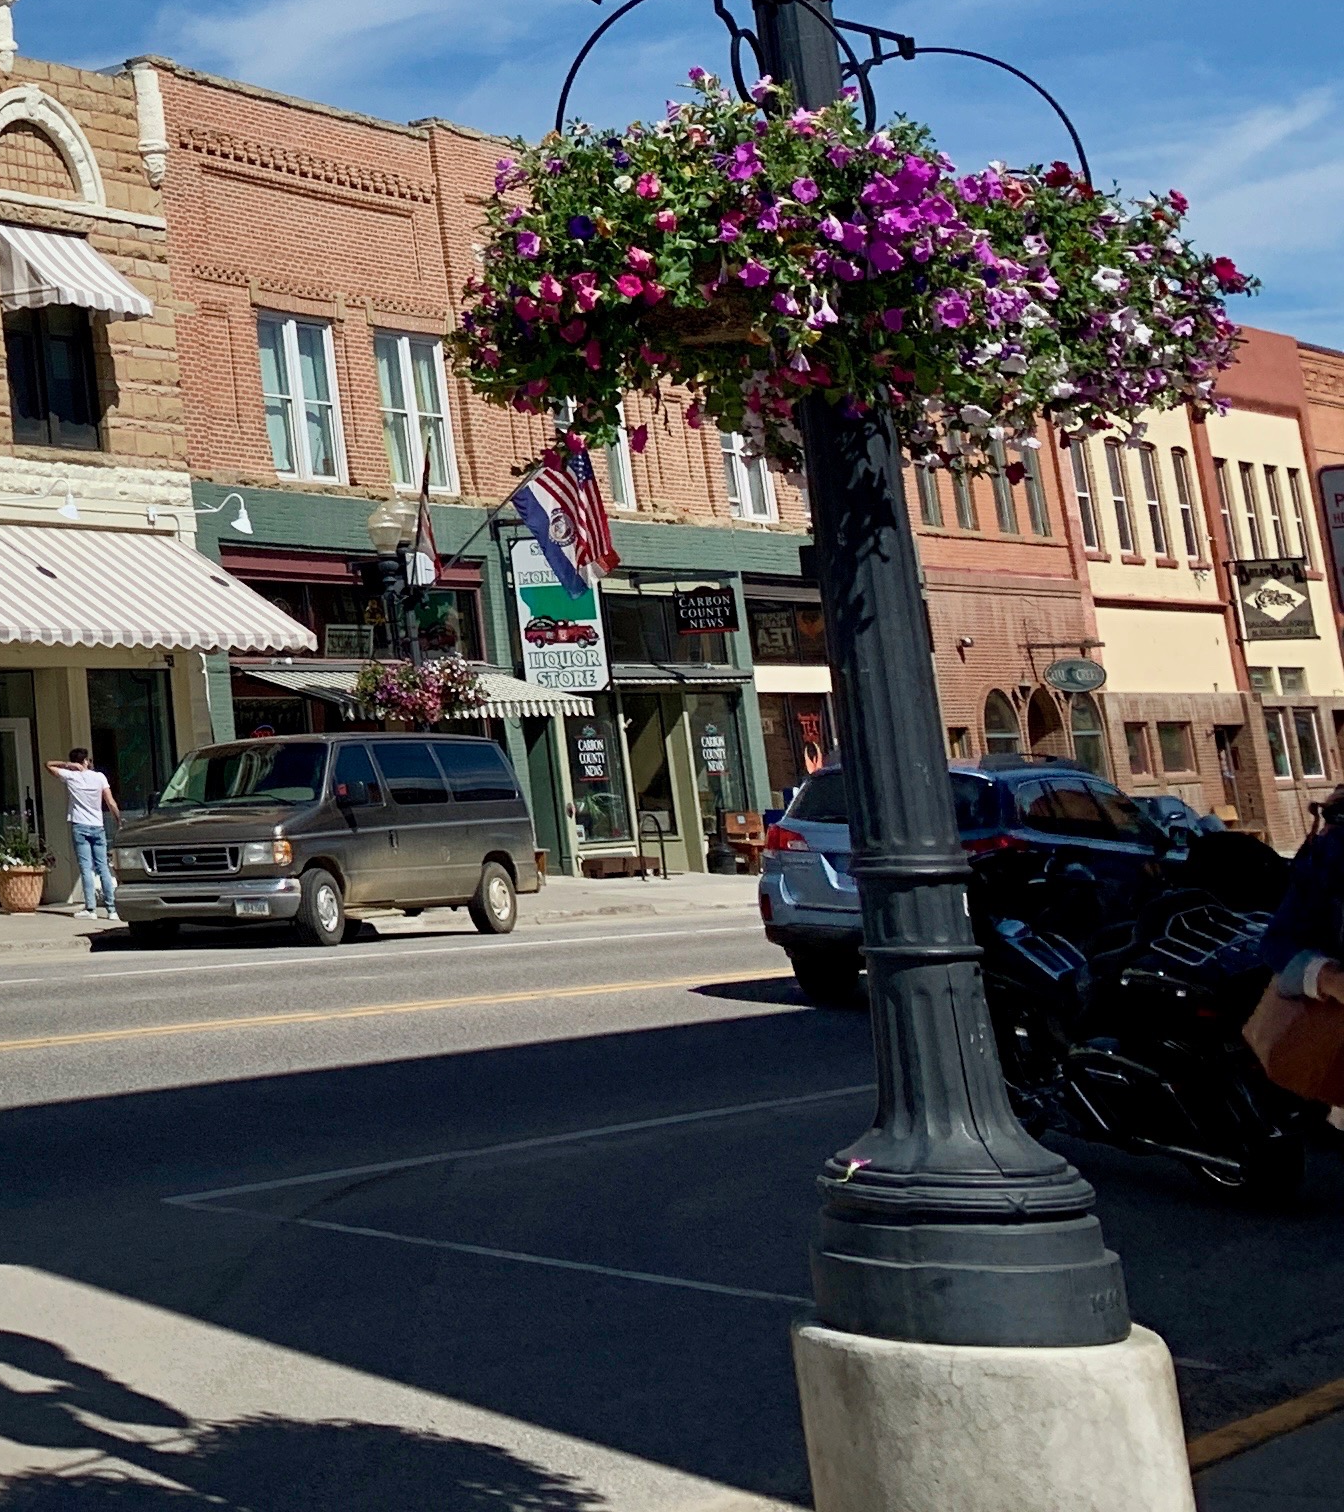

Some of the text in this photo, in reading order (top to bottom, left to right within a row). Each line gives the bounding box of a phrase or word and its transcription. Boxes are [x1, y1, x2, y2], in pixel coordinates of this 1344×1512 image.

[678, 595, 731, 608] CARBON
[680, 606, 731, 619] COUNTY
[690, 617, 725, 629] NEWS
[529, 650, 602, 670] LIQUOR
[537, 670, 598, 688] STORE
